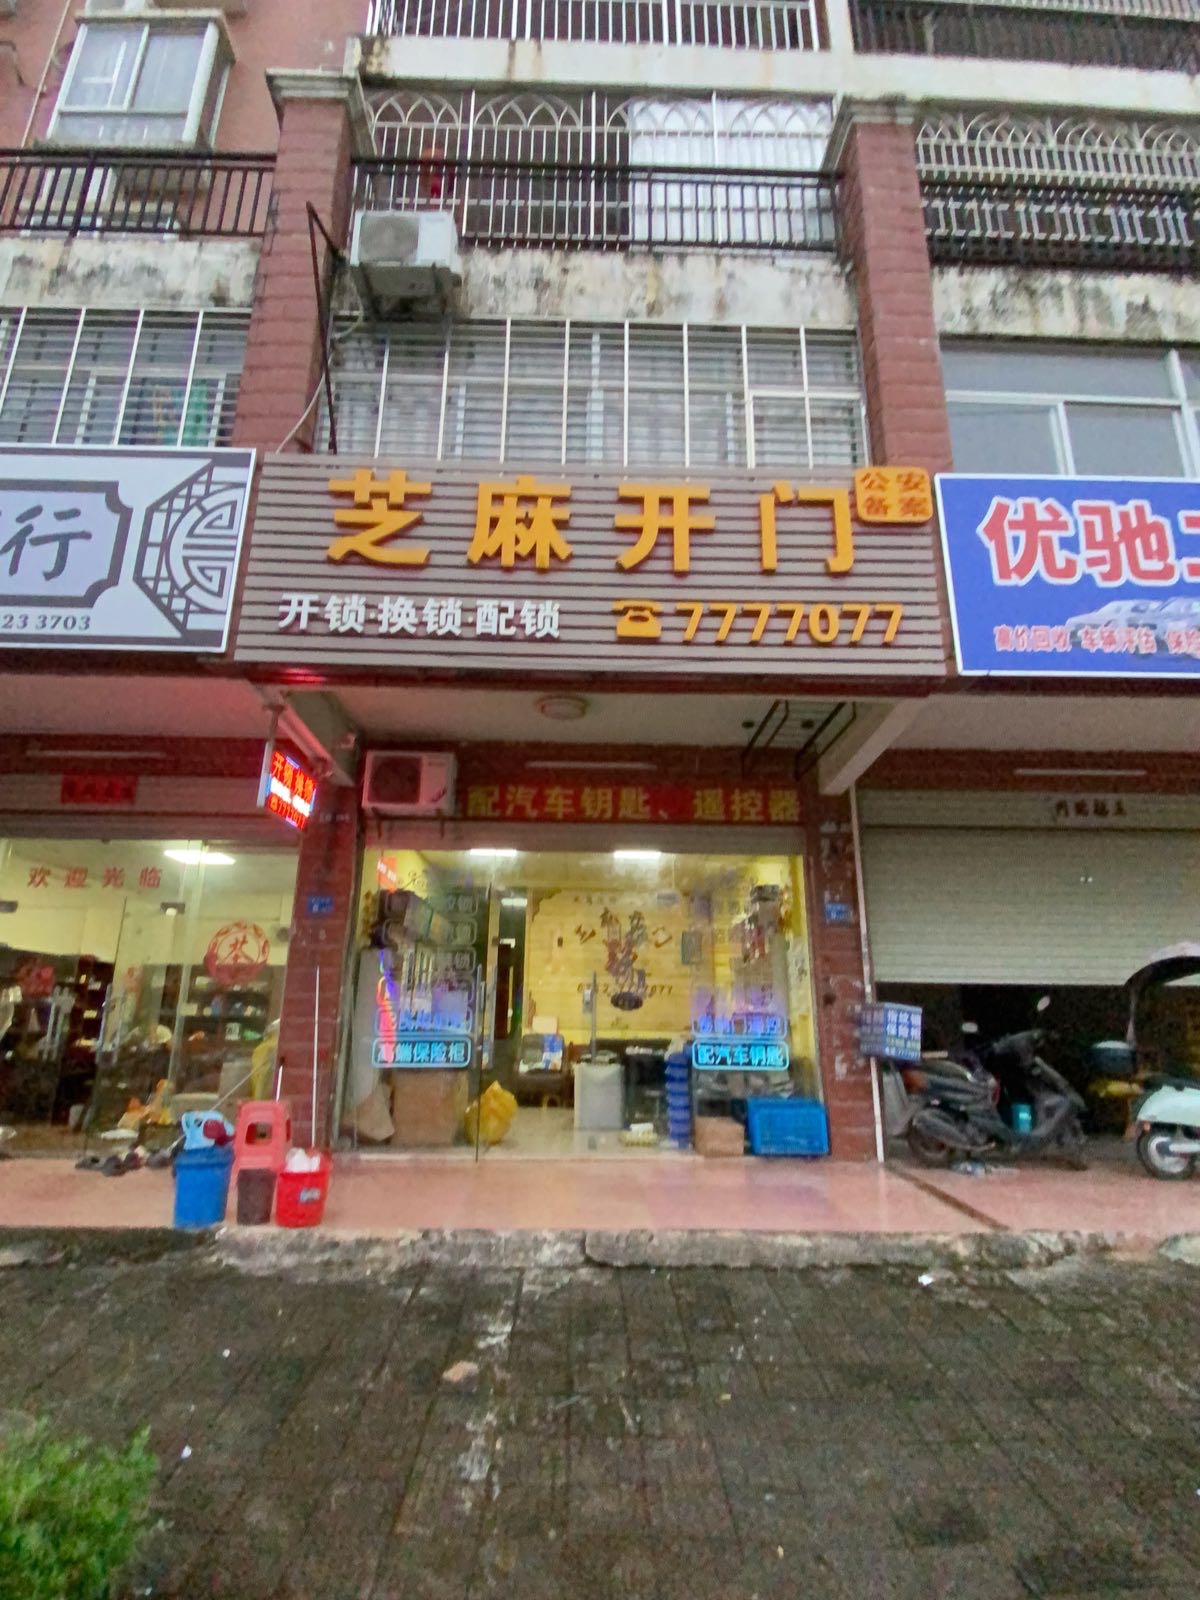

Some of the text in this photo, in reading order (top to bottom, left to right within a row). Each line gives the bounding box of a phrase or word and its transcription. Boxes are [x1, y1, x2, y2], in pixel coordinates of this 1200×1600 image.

[861, 472, 925, 492] 公安
[327, 468, 855, 574] 芝麻开门
[674, 602, 903, 645] 7777077
[27, 866, 163, 889] 欢迎光临
[697, 1044, 784, 1067] 配汽车钥匙
